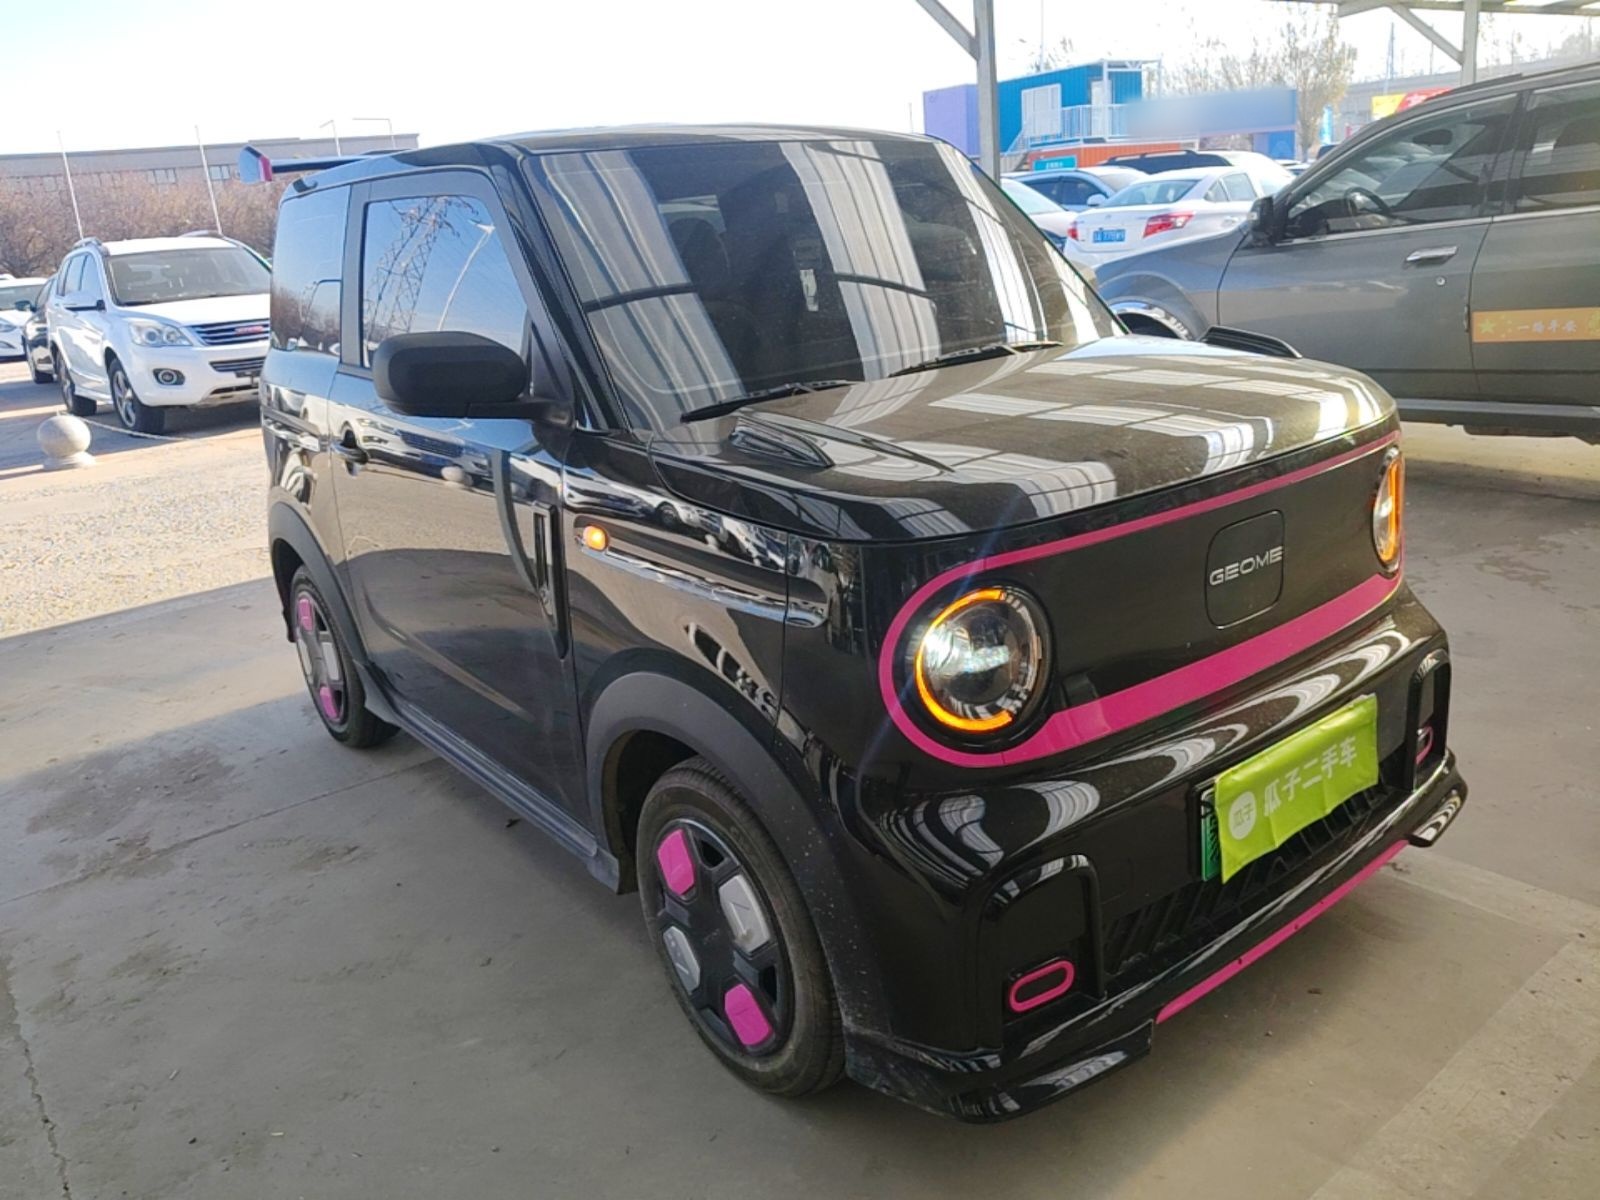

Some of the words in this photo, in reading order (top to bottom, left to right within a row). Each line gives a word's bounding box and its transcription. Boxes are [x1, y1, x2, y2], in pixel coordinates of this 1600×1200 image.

[1209, 546, 1282, 586] GEOME
[1264, 736, 1357, 817] 瓜子二手车
